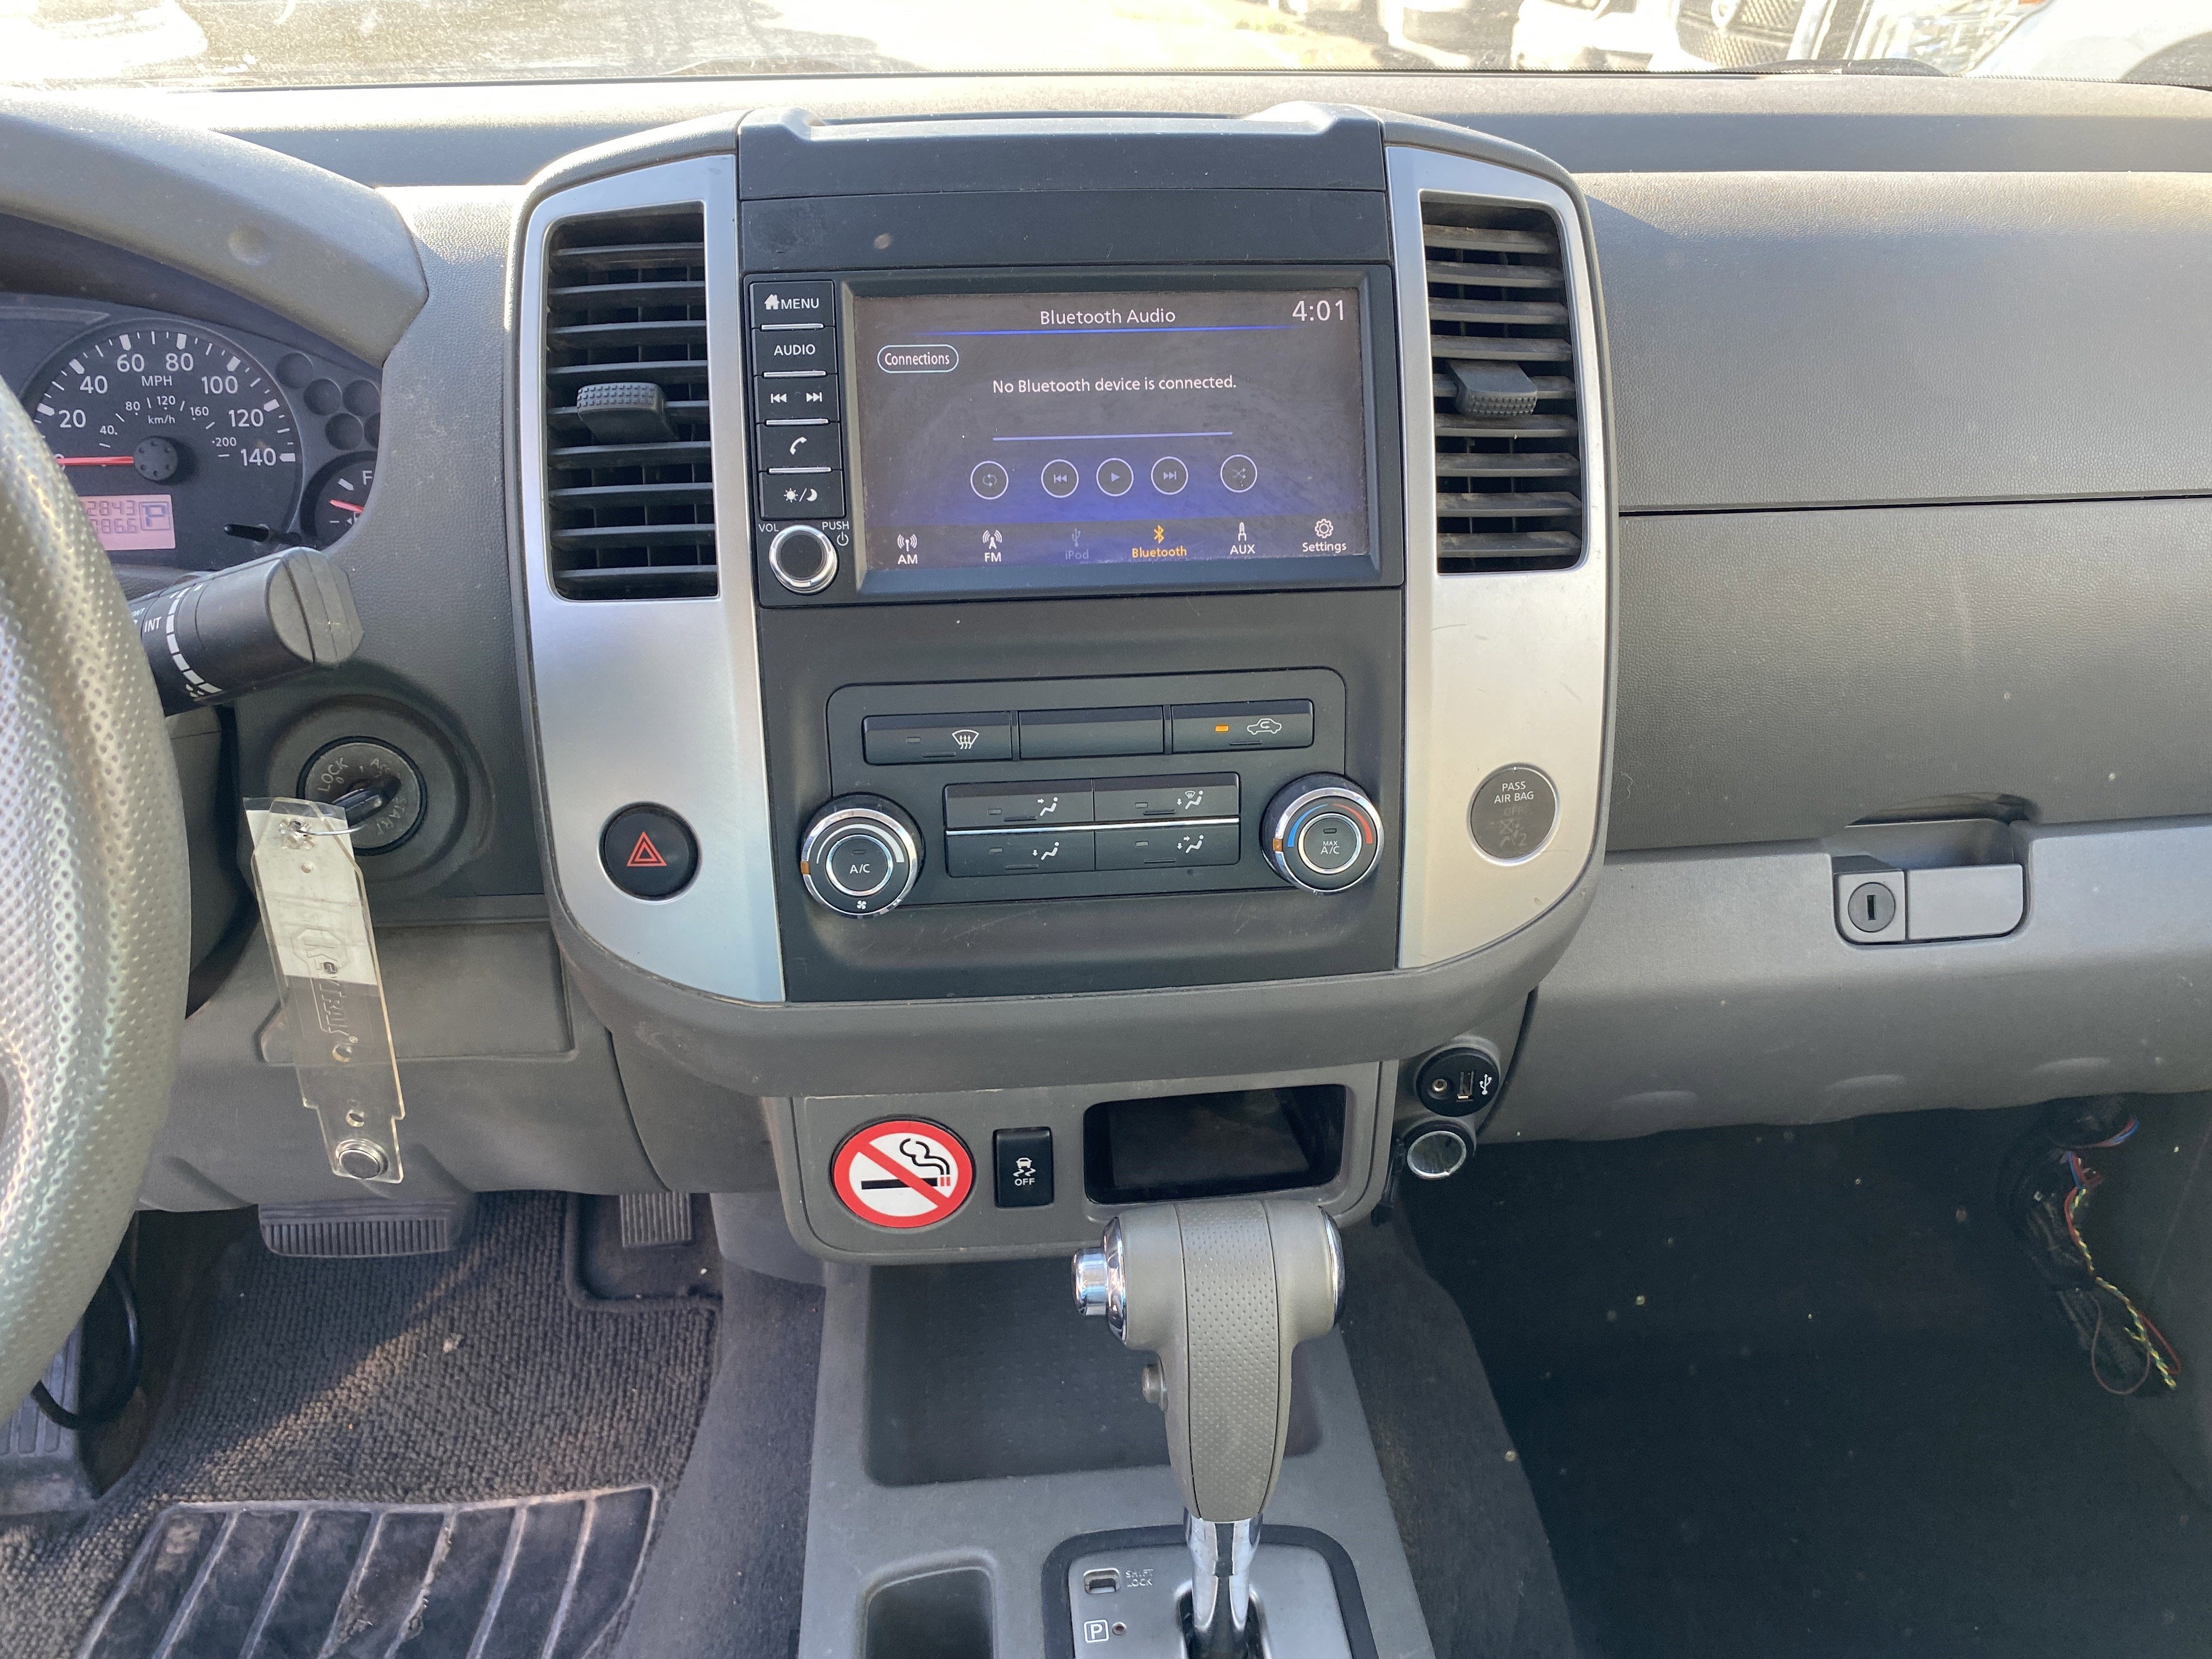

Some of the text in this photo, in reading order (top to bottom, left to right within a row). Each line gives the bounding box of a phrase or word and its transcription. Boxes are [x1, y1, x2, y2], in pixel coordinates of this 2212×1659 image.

[781, 298, 819, 309] MENU
[1041, 308, 1176, 324] Bluetooth Audio
[1293, 300, 1344, 321] 4:01
[774, 344, 816, 356] AUDIO
[117, 354, 145, 372] 60
[166, 353, 194, 371] 80
[884, 352, 950, 365] Connections
[80, 375, 108, 393] 40
[142, 375, 172, 387] MPH
[202, 375, 238, 394] 100
[993, 375, 1237, 393] No Bluetooth device is connected.
[126, 401, 140, 411] 80
[157, 396, 176, 405] 120
[190, 407, 209, 416] 160
[59, 409, 86, 428] 20
[148, 415, 175, 424] km/h
[228, 409, 264, 427] 120
[100, 425, 114, 435] 40
[216, 437, 236, 447] 200
[240, 448, 276, 466] 140
[363, 470, 373, 486] F
[758, 523, 780, 532] VOL
[822, 521, 849, 530] PUSH
[1132, 546, 1187, 558] Bluetooth
[1230, 544, 1255, 555] AUX
[1302, 541, 1347, 553] Settings
[898, 554, 918, 565] AM
[985, 552, 1001, 562] FM
[1065, 549, 1089, 560] iPod
[144, 617, 162, 633] INT
[318, 758, 348, 792] LOCK
[1502, 781, 1526, 792] PASS
[1494, 791, 1534, 804] AIR BAG
[377, 797, 407, 834] START
[1321, 845, 1339, 855] A/C
[849, 864, 870, 874] A/C
[1015, 1178, 1035, 1186] OFF
[1090, 1623, 1103, 1639] P
